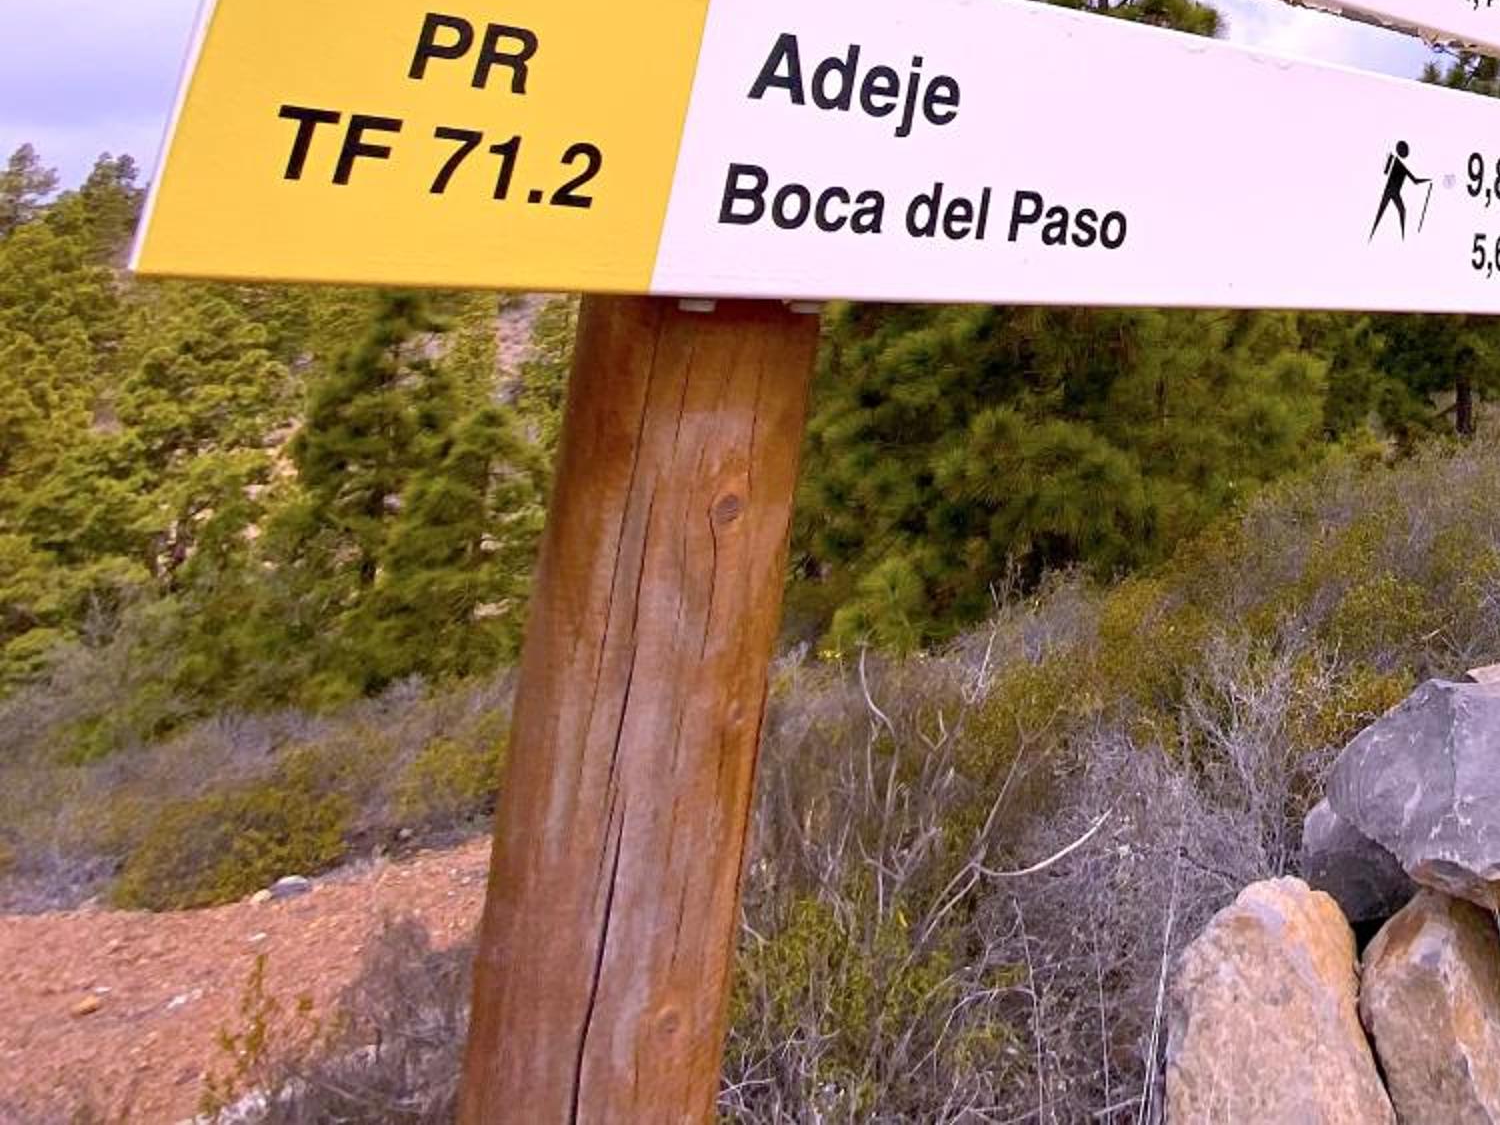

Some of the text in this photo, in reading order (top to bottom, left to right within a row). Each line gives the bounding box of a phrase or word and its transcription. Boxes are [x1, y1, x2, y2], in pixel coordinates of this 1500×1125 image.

[407, 12, 539, 95] PR
[747, 32, 961, 138] Adeje
[277, 104, 603, 209] TF 71.2
[718, 162, 1127, 250] Boca del Paso
